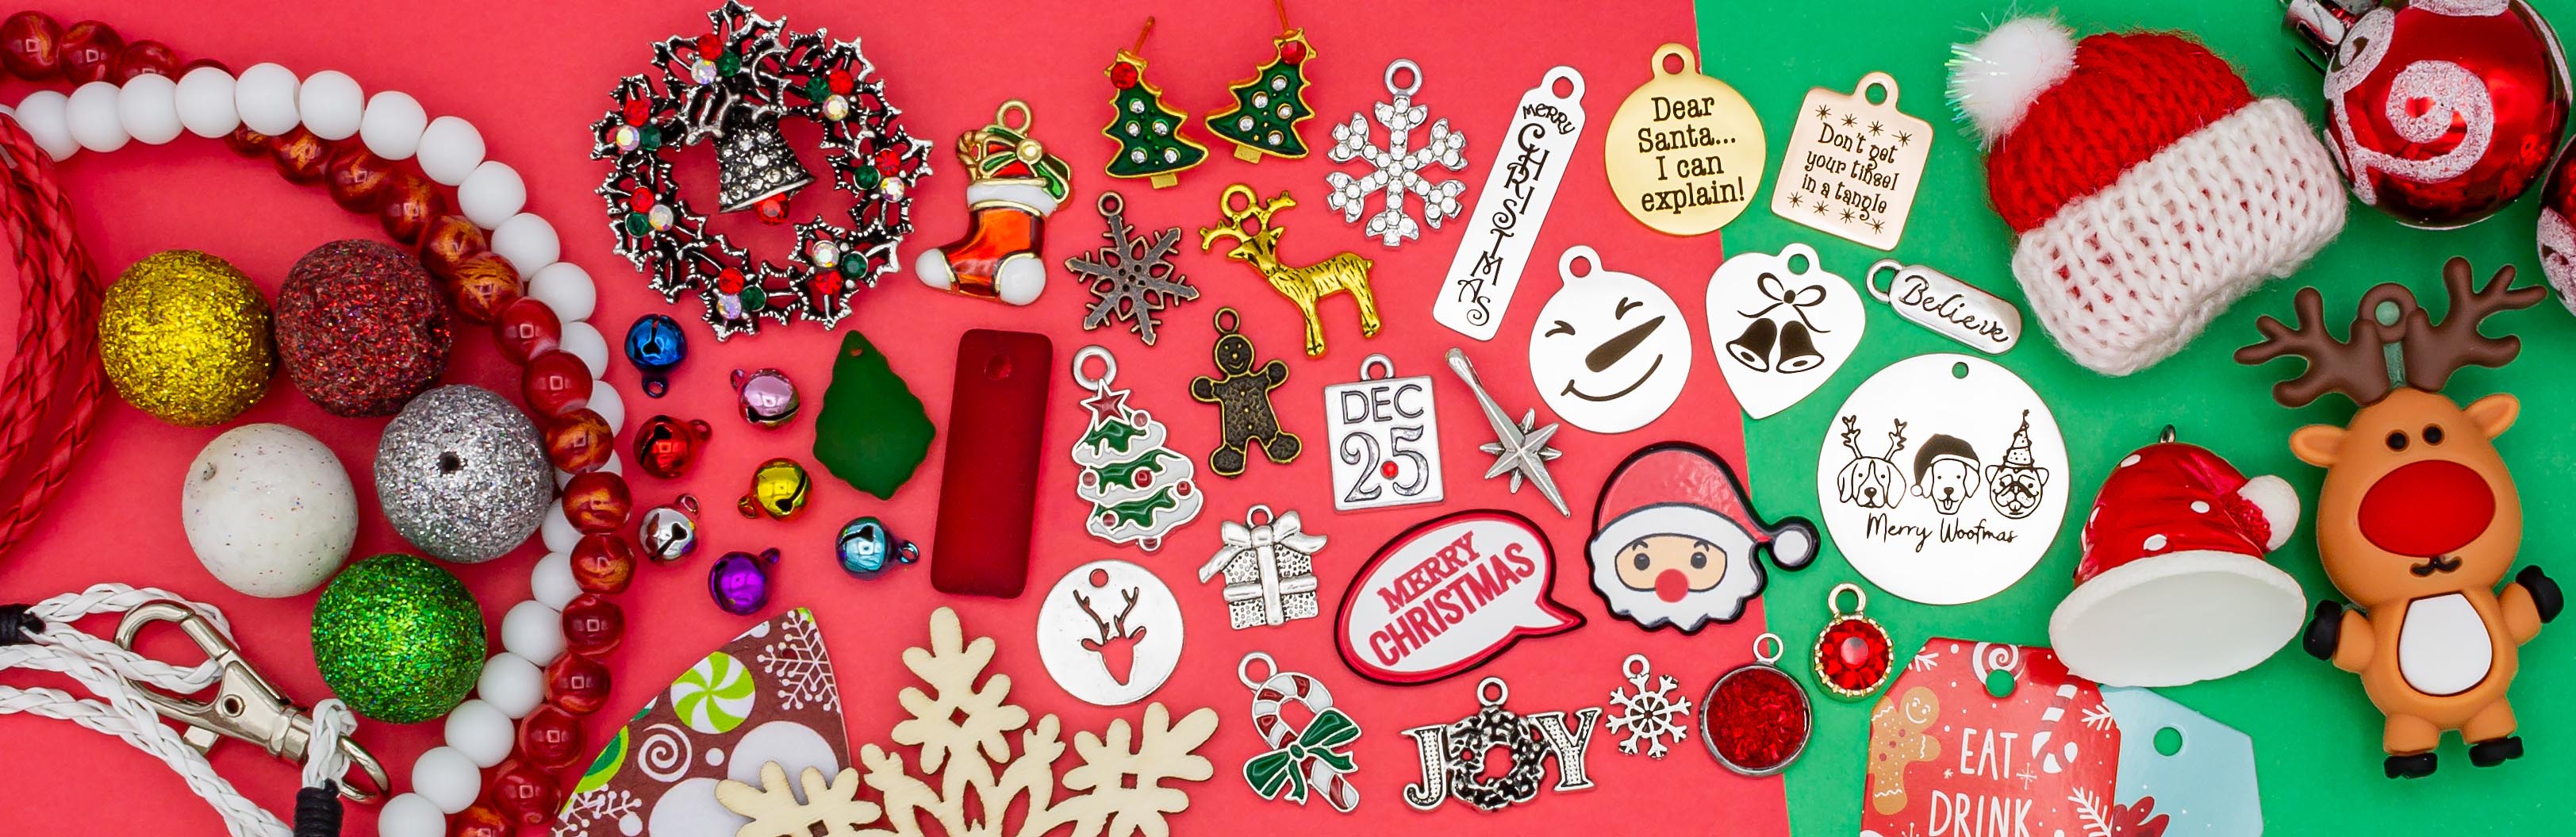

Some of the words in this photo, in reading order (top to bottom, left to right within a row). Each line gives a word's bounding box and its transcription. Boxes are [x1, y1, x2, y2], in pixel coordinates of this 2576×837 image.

[1651, 96, 1714, 122] Dear
[1637, 124, 1737, 153] Santa...
[1818, 123, 1867, 153] Don't
[1868, 144, 1898, 171] get
[1657, 155, 1668, 181] I
[1677, 155, 1724, 177] can
[1804, 151, 1847, 175] your
[1849, 160, 1900, 191] tinsel
[1641, 176, 1745, 214] explain!
[1801, 174, 1816, 194] in
[1820, 181, 1830, 197] a
[1834, 181, 1888, 221] tangle
[1457, 123, 1550, 326] CHRISTMAS
[1898, 275, 2009, 343] Believe
[1340, 384, 1425, 425] DEC
[1339, 424, 1430, 503] 25
[1866, 512, 1933, 553] Merry
[1939, 516, 2018, 545] Woofmas
[1376, 530, 1481, 615] MERRY
[1368, 542, 1536, 668] CHRISTMAS
[1400, 706, 1603, 812] JOY
[1960, 728, 2019, 781] EAT
[1928, 789, 2033, 837] DRINK
